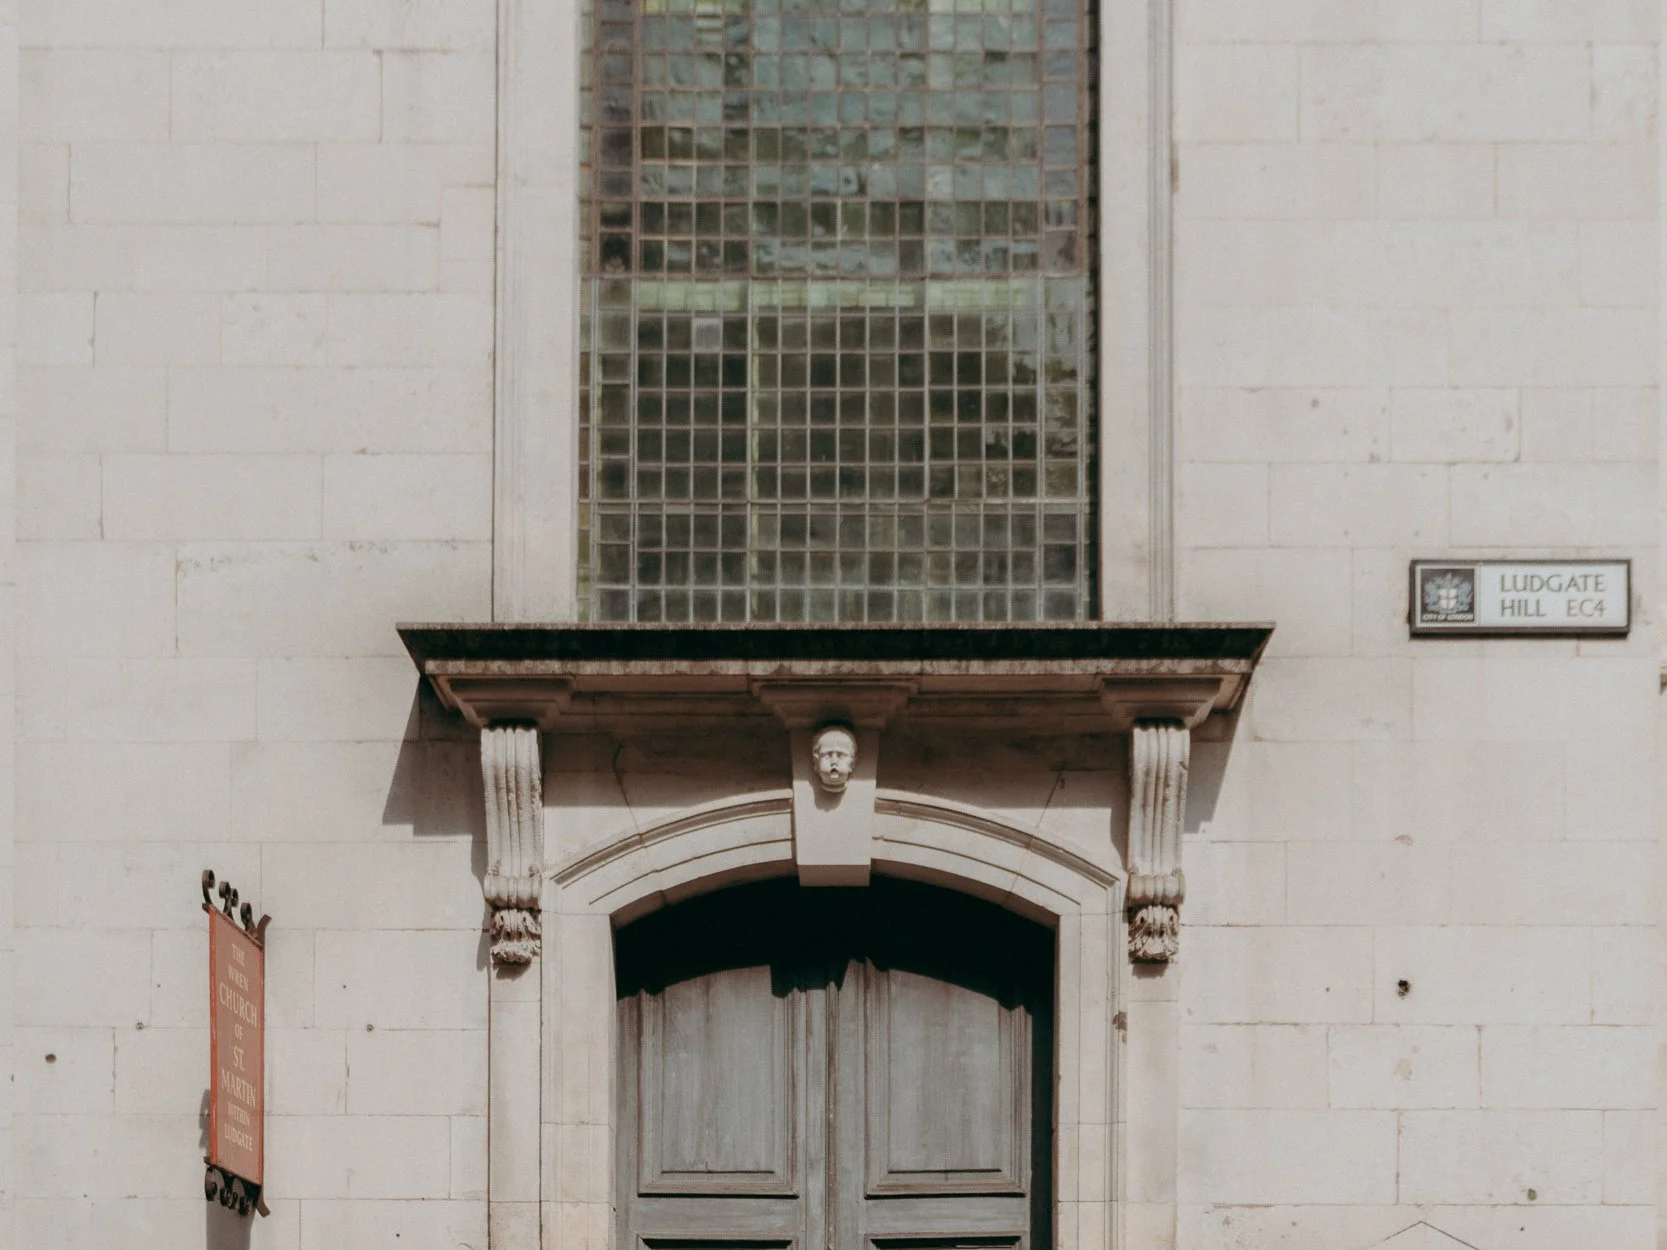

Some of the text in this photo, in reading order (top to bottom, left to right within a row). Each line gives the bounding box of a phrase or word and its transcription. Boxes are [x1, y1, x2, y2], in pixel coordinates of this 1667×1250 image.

[1500, 574, 1606, 593] LUDGATE
[1423, 613, 1474, 621] CITY OF LONDON
[1500, 599, 1607, 618] HILL EC4
[231, 943, 245, 967] THE
[228, 964, 249, 992] WREN
[220, 981, 257, 1028] CHURCH
[235, 1023, 243, 1040] OF
[221, 1066, 256, 1107] MARTIN
[228, 1101, 250, 1127] WITHIN
[224, 1123, 253, 1152] LUDGATE
